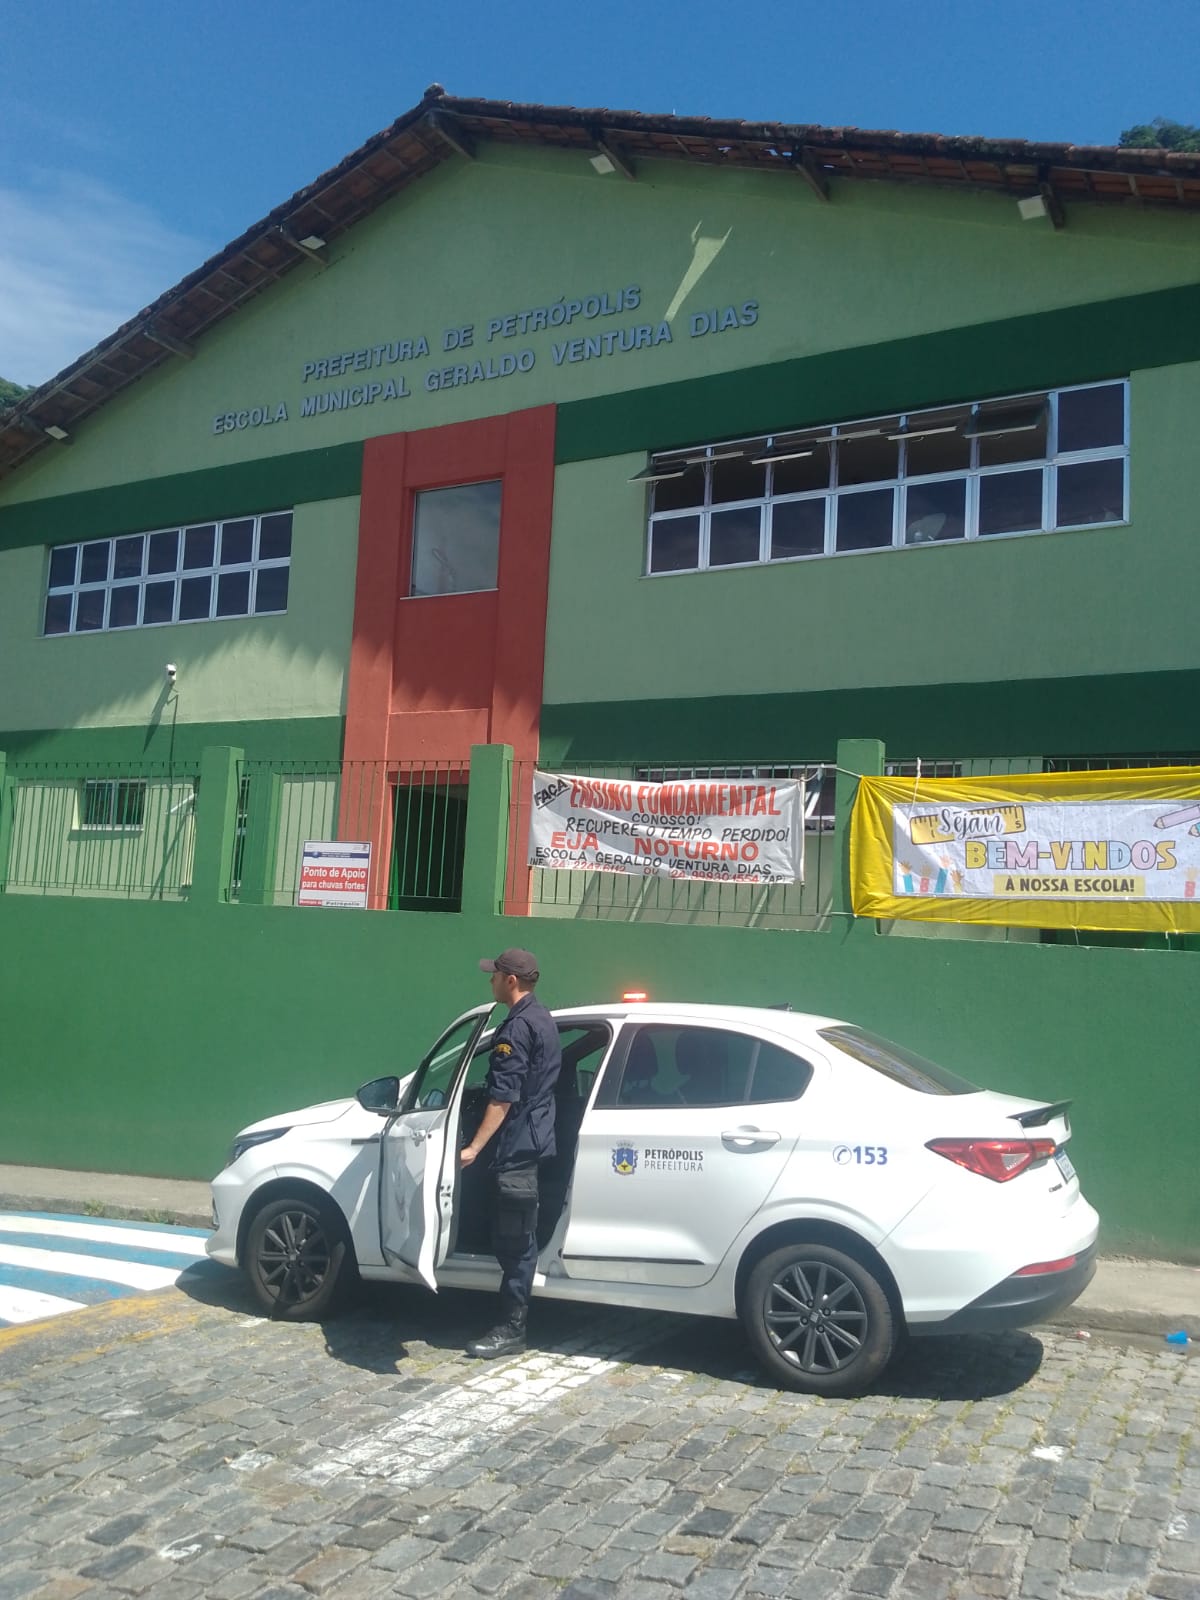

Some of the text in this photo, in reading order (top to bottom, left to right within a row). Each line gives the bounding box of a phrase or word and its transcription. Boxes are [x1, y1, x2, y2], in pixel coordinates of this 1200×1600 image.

[302, 285, 641, 384] PREFEITURA DE PETRÓPOLIS
[213, 300, 759, 435] ESCOLA MUNICIPAL GERALDO VENTURA DIAS
[569, 778, 782, 816] ENSINO FUNDAMENTAL
[565, 817, 790, 842] RECUPERE O TEMPO PERDIDO!
[631, 813, 701, 826] CONOSCO!
[940, 808, 1003, 840] Sejam
[551, 831, 759, 861] EJA NOTURNO
[965, 840, 1178, 871] BEM-VINDOS
[535, 847, 772, 875] ESCOLA GERALDO VENTURA DIAS
[644, 867, 659, 875] OU
[303, 867, 366, 880] Ponto de Apoio
[1005, 876, 1135, 893] À NOSSA ESCOLA!
[301, 880, 365, 890] para chuvas fortes
[644, 1148, 703, 1161] PETRÓPOLIS
[852, 1145, 888, 1165] 153
[644, 1160, 703, 1172] PREFEITURA
